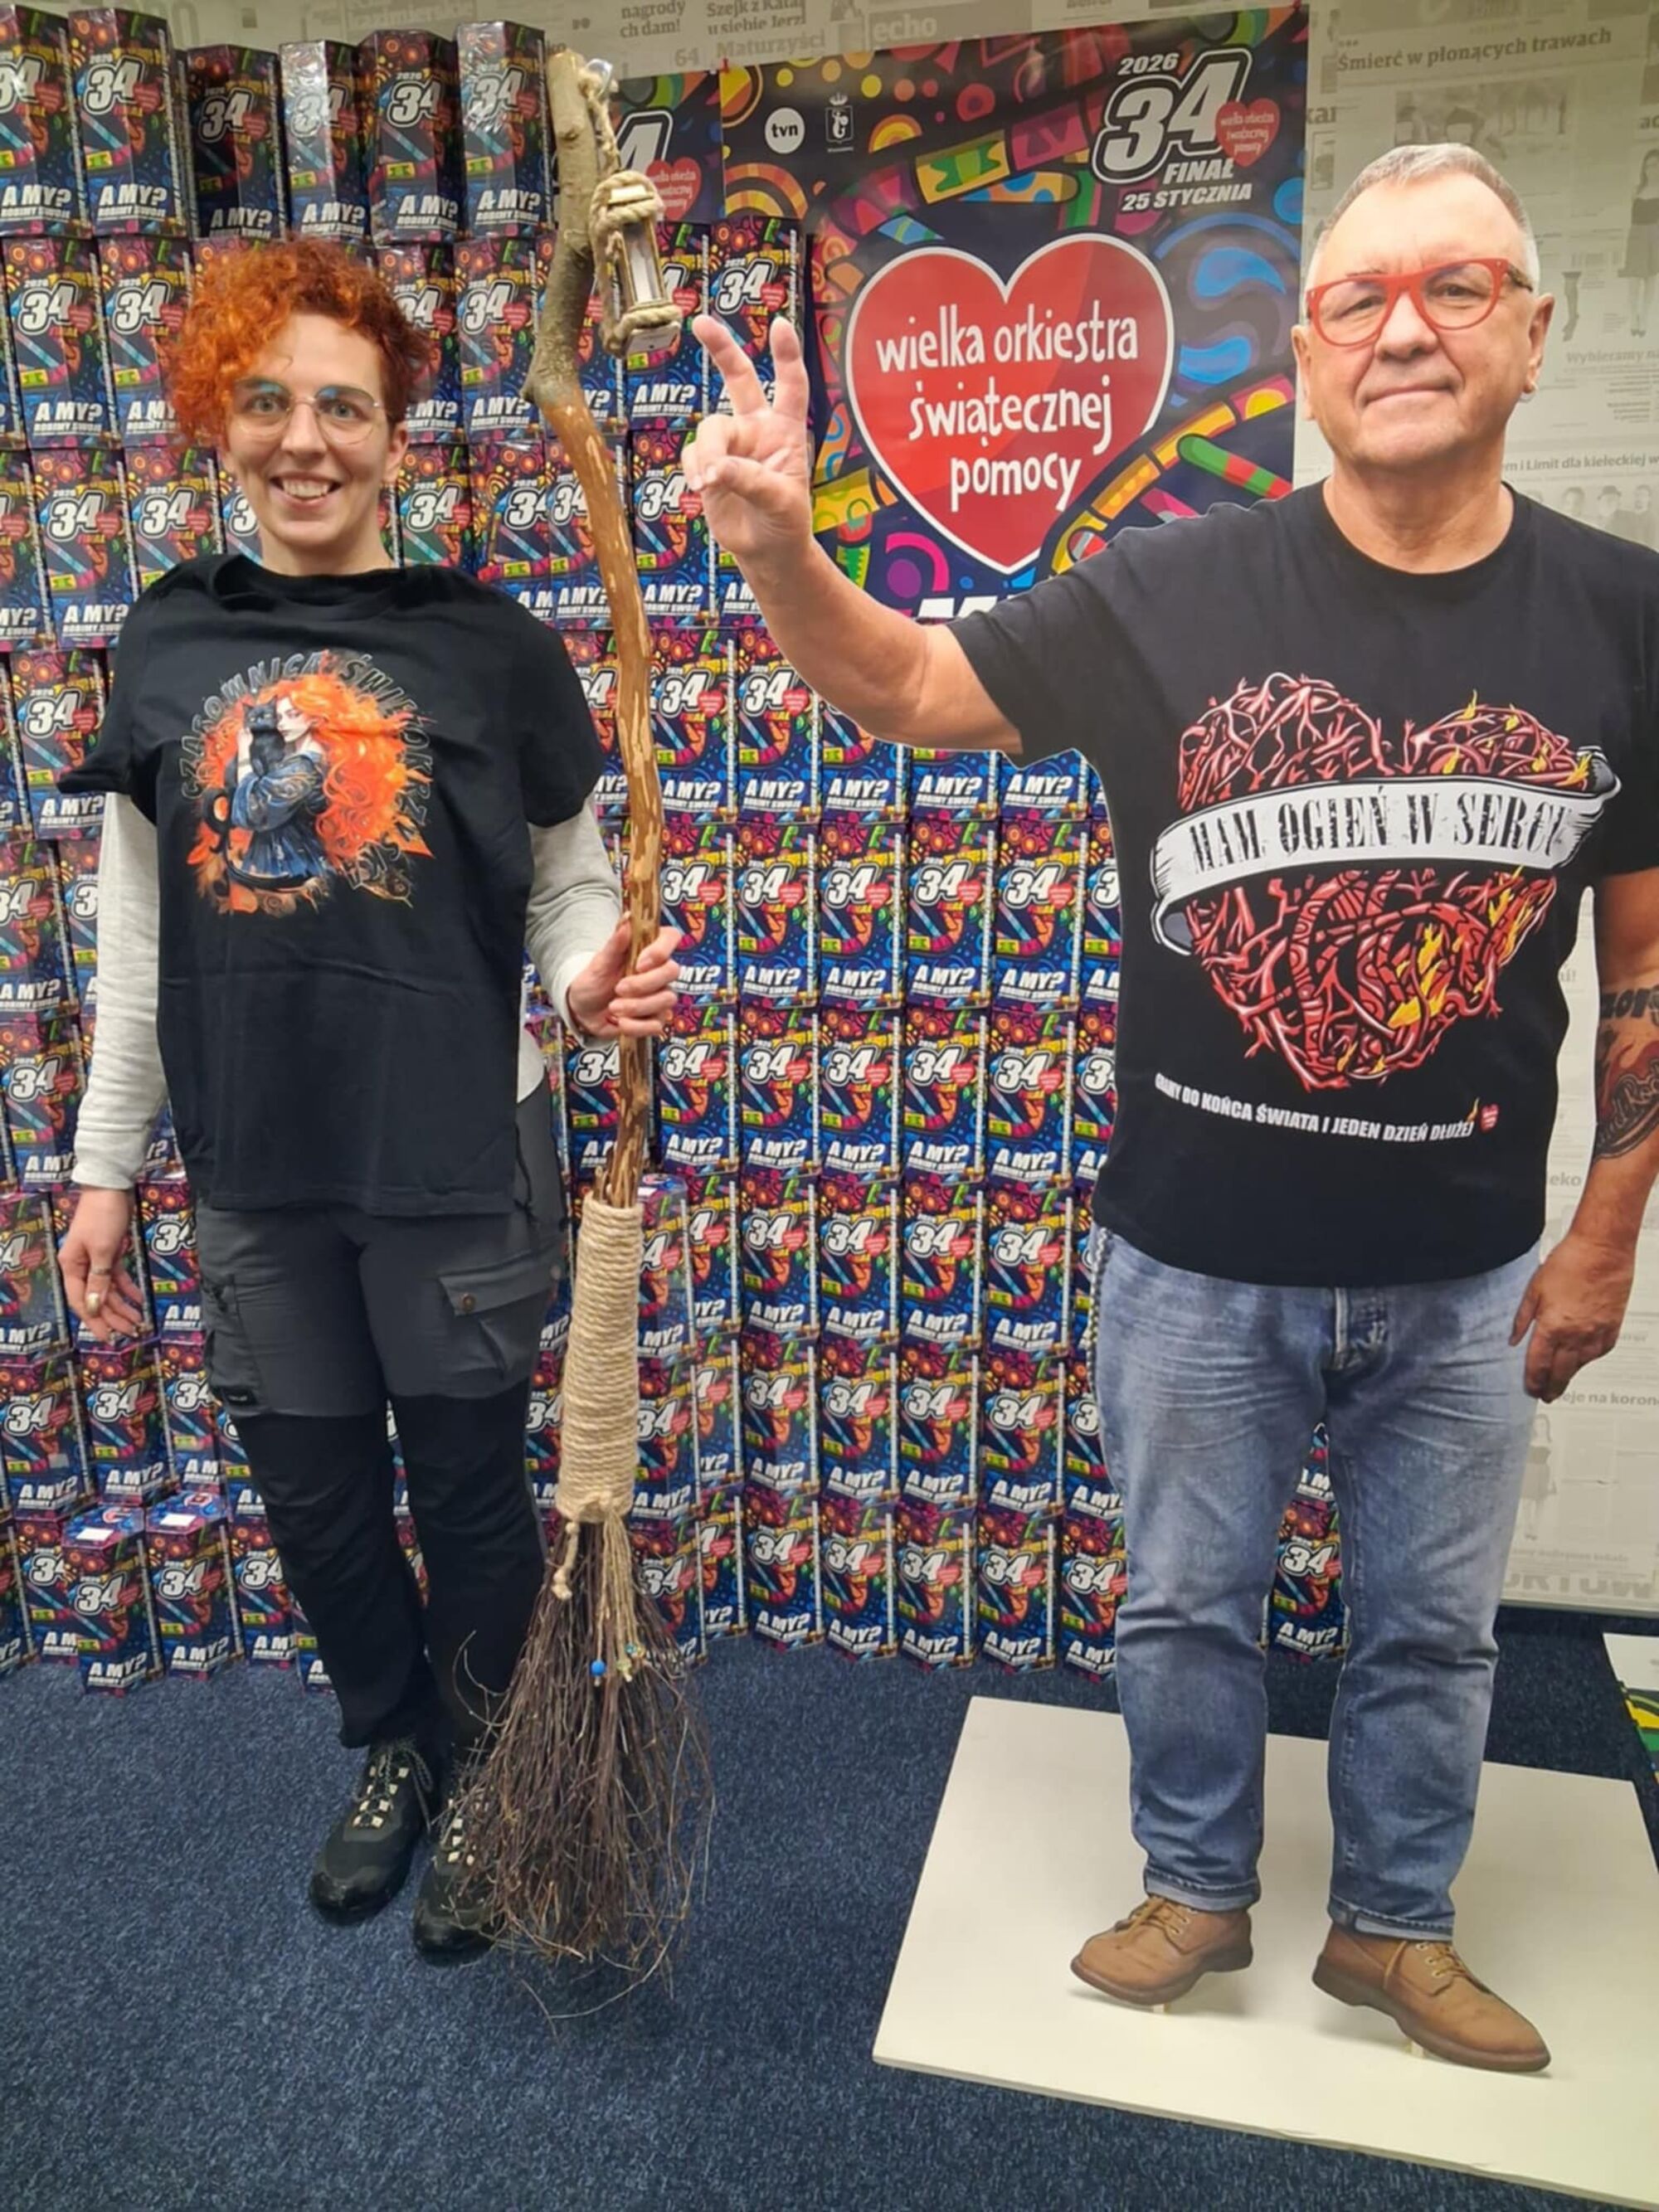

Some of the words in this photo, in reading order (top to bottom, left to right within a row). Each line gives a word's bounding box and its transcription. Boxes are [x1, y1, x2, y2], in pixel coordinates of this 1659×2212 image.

[641, 17, 681, 35] dam!
[873, 15, 937, 42] echo
[674, 47, 700, 67] 64
[1118, 53, 1180, 75] 2026
[1337, 47, 1404, 73] Śmierć
[1408, 51, 1423, 66] w
[1427, 38, 1526, 69] płonących
[1530, 27, 1613, 53] trawach
[85, 60, 144, 112] 34
[468, 68, 522, 116] 34
[201, 90, 250, 140] 34
[387, 82, 439, 125] 34
[1097, 51, 1248, 178] 34
[771, 123, 799, 138] tvn
[1163, 158, 1234, 184] FINAŁ
[98, 183, 116, 206] A
[119, 184, 167, 206] MY?
[397, 195, 416, 216] A
[413, 196, 458, 217] MY?
[478, 192, 496, 213] A
[495, 192, 540, 212] MY?
[1121, 192, 1151, 211] 25
[1153, 182, 1253, 209] STYCZNIA
[303, 204, 321, 225] A
[321, 206, 366, 226] MY?
[718, 262, 771, 313] 34
[20, 282, 77, 333] 34
[114, 282, 168, 333] 34
[464, 281, 514, 333] 34
[876, 304, 985, 373] wielka
[994, 299, 1138, 364] orkiestra
[473, 396, 486, 416] A
[488, 396, 532, 415] MY?
[635, 384, 649, 404] A
[651, 384, 697, 403] MY?
[35, 402, 52, 421] A
[54, 402, 104, 421] MY?
[908, 375, 1112, 455] świątecznej
[1562, 454, 1582, 469] dla
[1583, 452, 1647, 470] kieleckiej
[640, 472, 686, 519] 34
[950, 450, 1082, 513] pomocy
[49, 491, 103, 538] 34
[142, 489, 193, 536] 34
[408, 484, 460, 530] 34
[645, 586, 657, 602] A
[660, 585, 703, 603] MY?
[66, 605, 80, 622] A
[84, 605, 129, 623] MY?
[664, 672, 708, 716] 34
[745, 670, 793, 715] 34
[27, 691, 80, 735] 34
[663, 780, 674, 798] A
[679, 779, 721, 799] MY?
[745, 780, 757, 797] A
[761, 779, 805, 799] MY?
[830, 778, 844, 796] A
[846, 778, 891, 799] MY?
[918, 775, 935, 793] A
[938, 775, 983, 796] MY?
[1007, 775, 1024, 793] A
[1028, 775, 1074, 796] MY?
[42, 799, 57, 816] A
[61, 796, 105, 816] MY?
[1190, 808, 1264, 875] MAM
[1276, 785, 1389, 863] OGIEŃ
[1407, 793, 1442, 846] W
[1452, 791, 1572, 859] SERCU
[664, 865, 709, 904] 34
[744, 865, 791, 907] 34
[827, 863, 878, 907] 34
[917, 861, 969, 905] 34
[1006, 863, 1061, 908] 34
[679, 966, 722, 985] MY?
[746, 965, 757, 984] A
[761, 967, 802, 986] MY?
[828, 967, 841, 986] A
[843, 968, 887, 988] MY?
[915, 965, 929, 984] A
[932, 967, 976, 987] MY?
[1002, 970, 1017, 988] A
[1019, 971, 1066, 991] MY?
[665, 1042, 711, 1080] 34
[748, 1043, 796, 1086] 34
[828, 1045, 878, 1086] 34
[912, 1045, 963, 1086] 34
[997, 1052, 1050, 1092] 34
[11, 1057, 61, 1100] 34
[1182, 1086, 1200, 1106] DO
[1201, 1092, 1253, 1121] KOŃCA
[1255, 1103, 1320, 1133] ŚWIATA
[1321, 1116, 1329, 1133] I
[1330, 1117, 1381, 1139] JEDEN
[1382, 1121, 1428, 1143] DZIEŃ
[1429, 1120, 1475, 1141] DŁUŻEJ
[667, 1134, 680, 1151] A
[683, 1136, 723, 1155] MY?
[751, 1137, 763, 1155] A
[765, 1139, 808, 1159] MY?
[828, 1140, 842, 1159] A
[844, 1142, 886, 1162] MY?
[911, 1140, 924, 1158] A
[927, 1142, 970, 1163] MY?
[995, 1148, 1010, 1166] A
[1011, 1150, 1057, 1171] MY?
[749, 1213, 791, 1248] 34
[827, 1217, 874, 1256] 34
[911, 1218, 961, 1257] 34
[996, 1227, 1050, 1266] 34
[828, 1306, 841, 1325] A
[842, 1308, 886, 1328] MY?
[995, 1318, 1010, 1336] A
[1011, 1320, 1058, 1341] MY?
[7, 1393, 54, 1434] 34
[94, 1379, 142, 1421] 34
[827, 1382, 873, 1418] 34
[992, 1394, 1044, 1429] 34
[1588, 1393, 1608, 1404] na
[106, 1469, 121, 1487] A
[123, 1461, 164, 1485] MY?
[992, 1479, 1009, 1498] A
[1009, 1481, 1053, 1504] MY?
[752, 1531, 798, 1563] 34
[1281, 1544, 1332, 1574] 34
[159, 1560, 209, 1598] 34
[984, 1552, 1033, 1584] 34
[75, 1573, 126, 1614] 34
[985, 1630, 999, 1647] A
[1000, 1636, 1042, 1658] MY?
[89, 1663, 103, 1678] A
[105, 1652, 148, 1678] MY?
